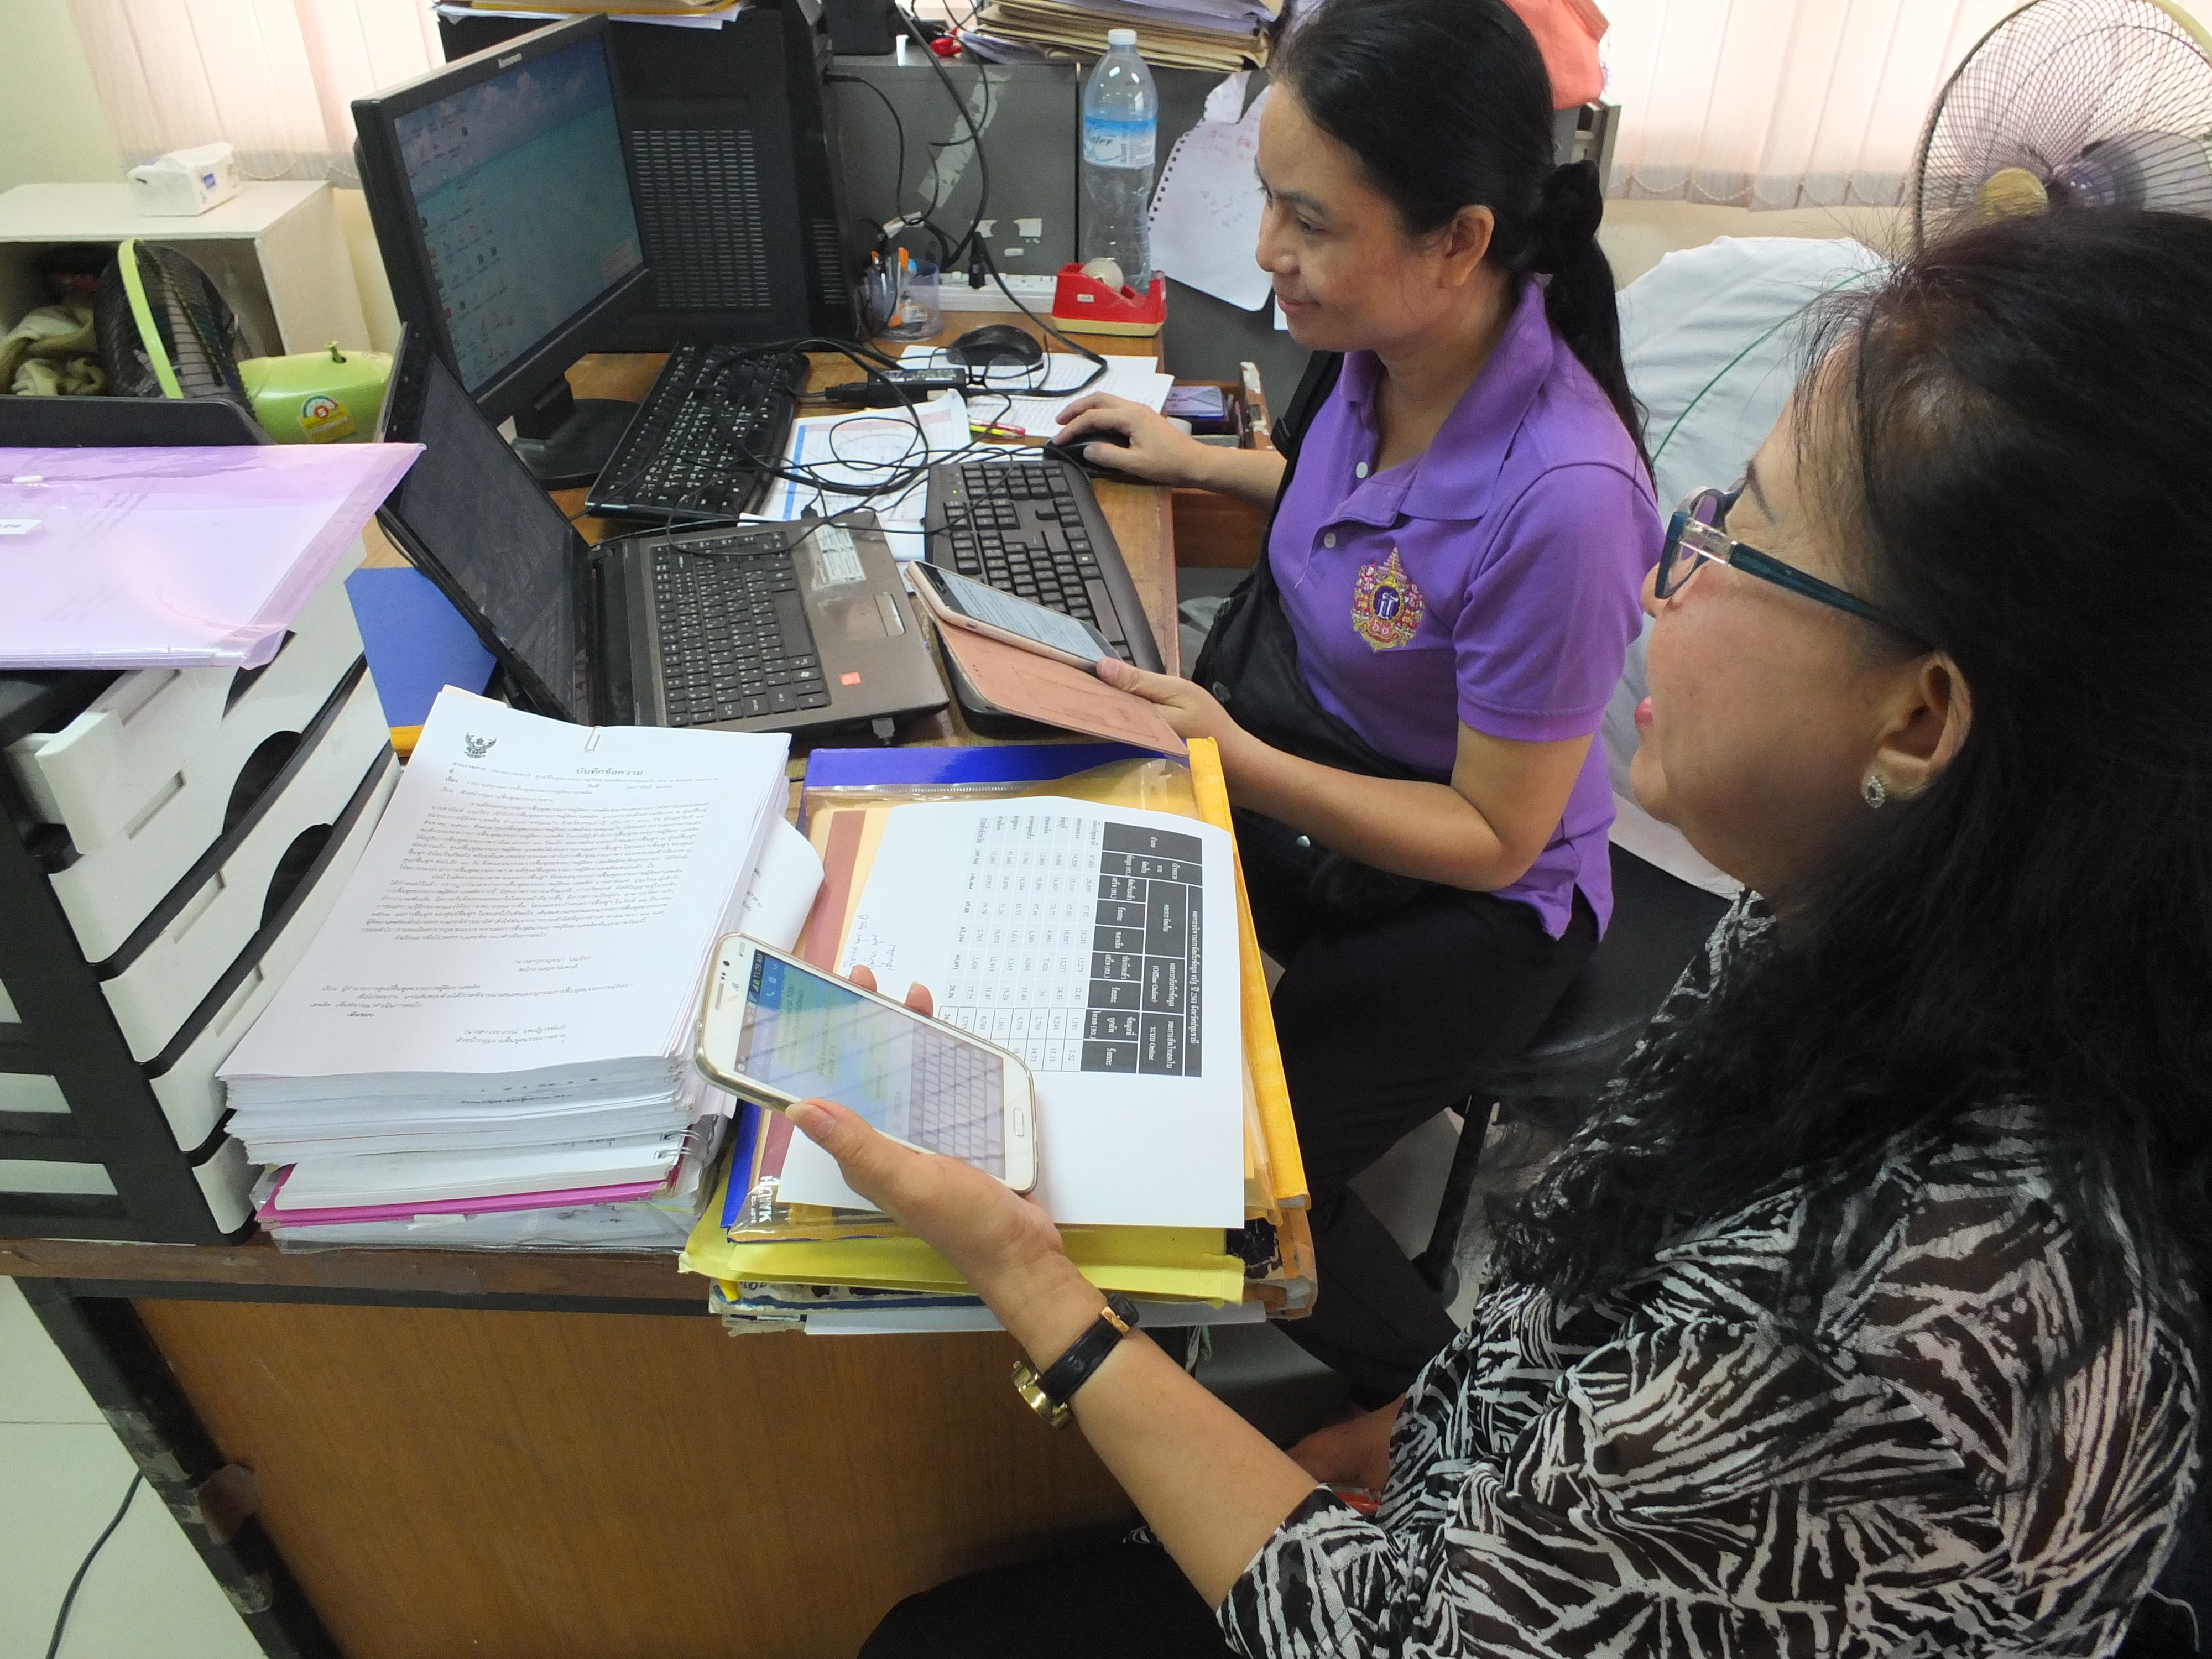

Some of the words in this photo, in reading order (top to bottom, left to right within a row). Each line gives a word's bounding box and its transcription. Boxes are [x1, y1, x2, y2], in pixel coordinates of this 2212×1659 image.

[576, 766, 643, 776] บันทึกข้อความ
